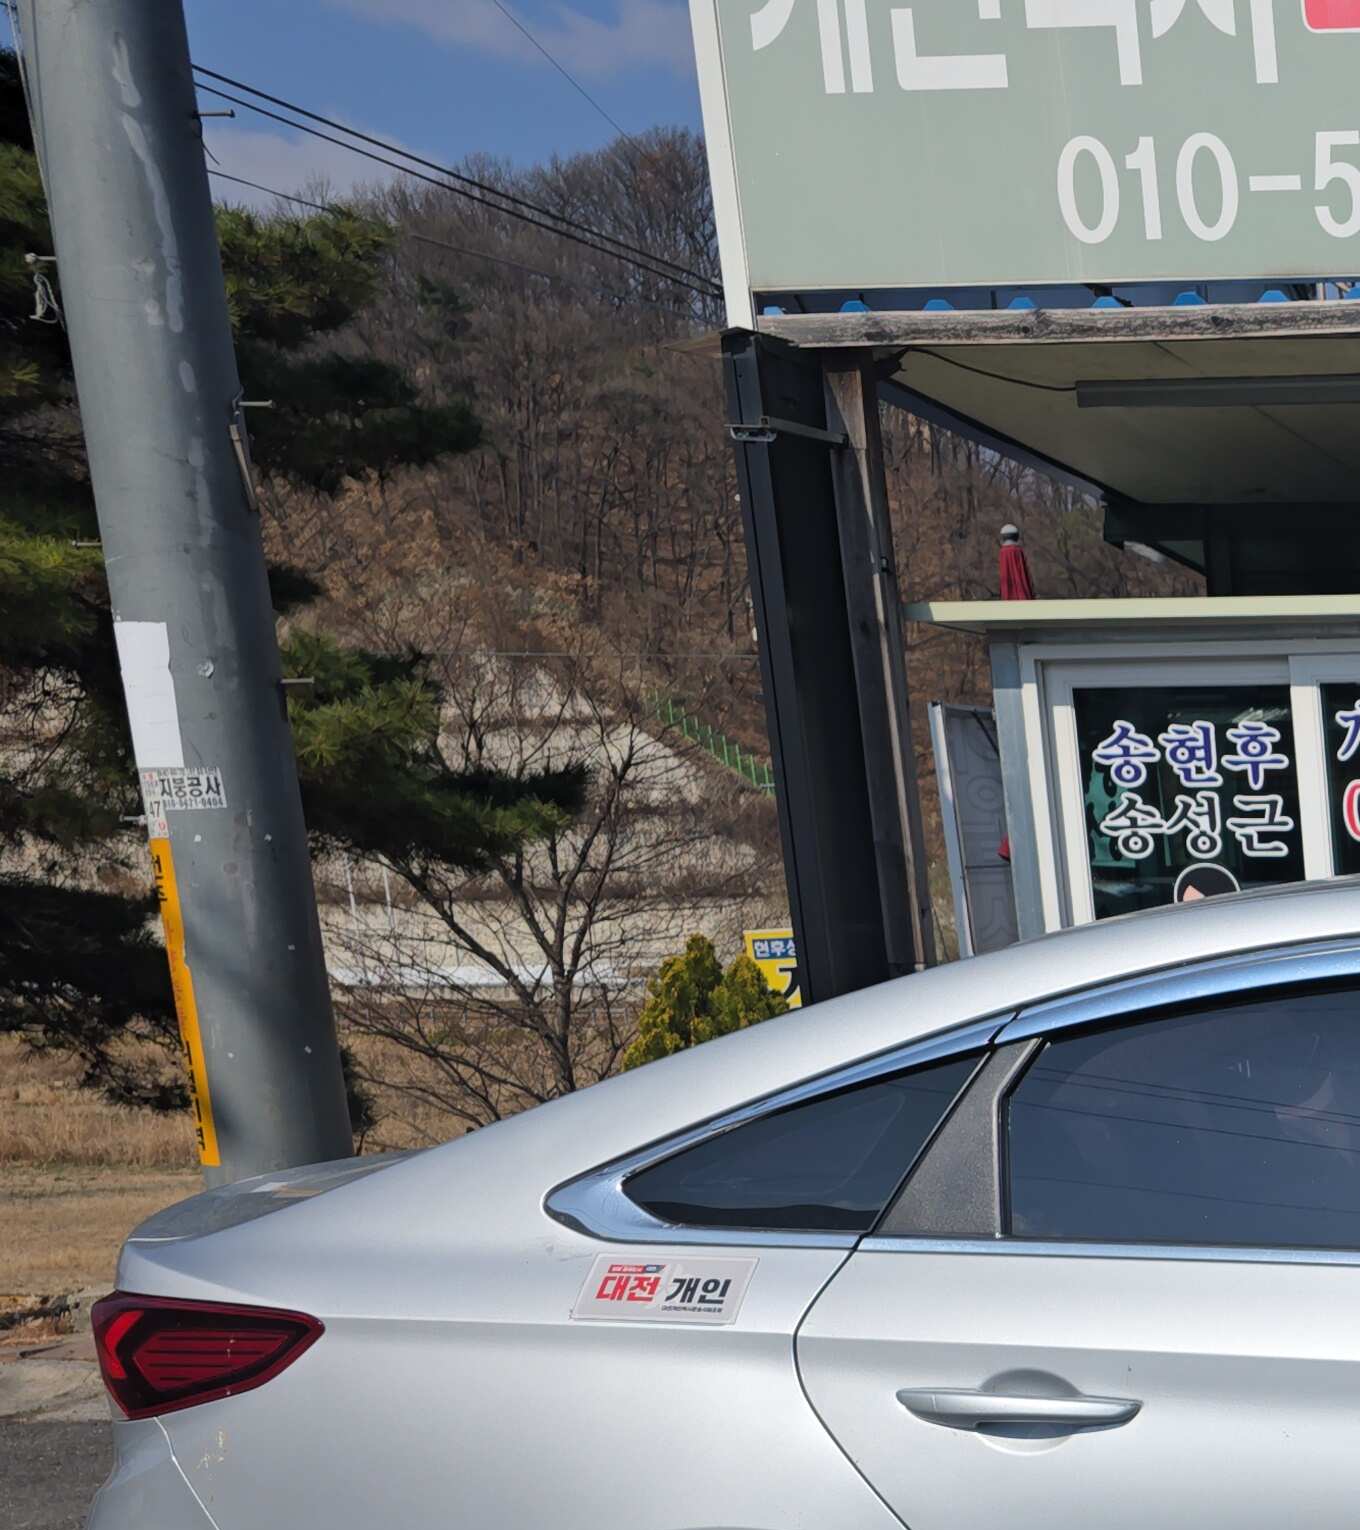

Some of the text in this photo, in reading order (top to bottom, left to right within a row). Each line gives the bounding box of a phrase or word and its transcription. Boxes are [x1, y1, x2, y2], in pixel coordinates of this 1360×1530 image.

[1092, 719, 1290, 791] 송현후
[159, 775, 222, 798] 지붕공사
[1100, 791, 1294, 860] 송성근
[595, 1275, 732, 1305] 대전 개인
